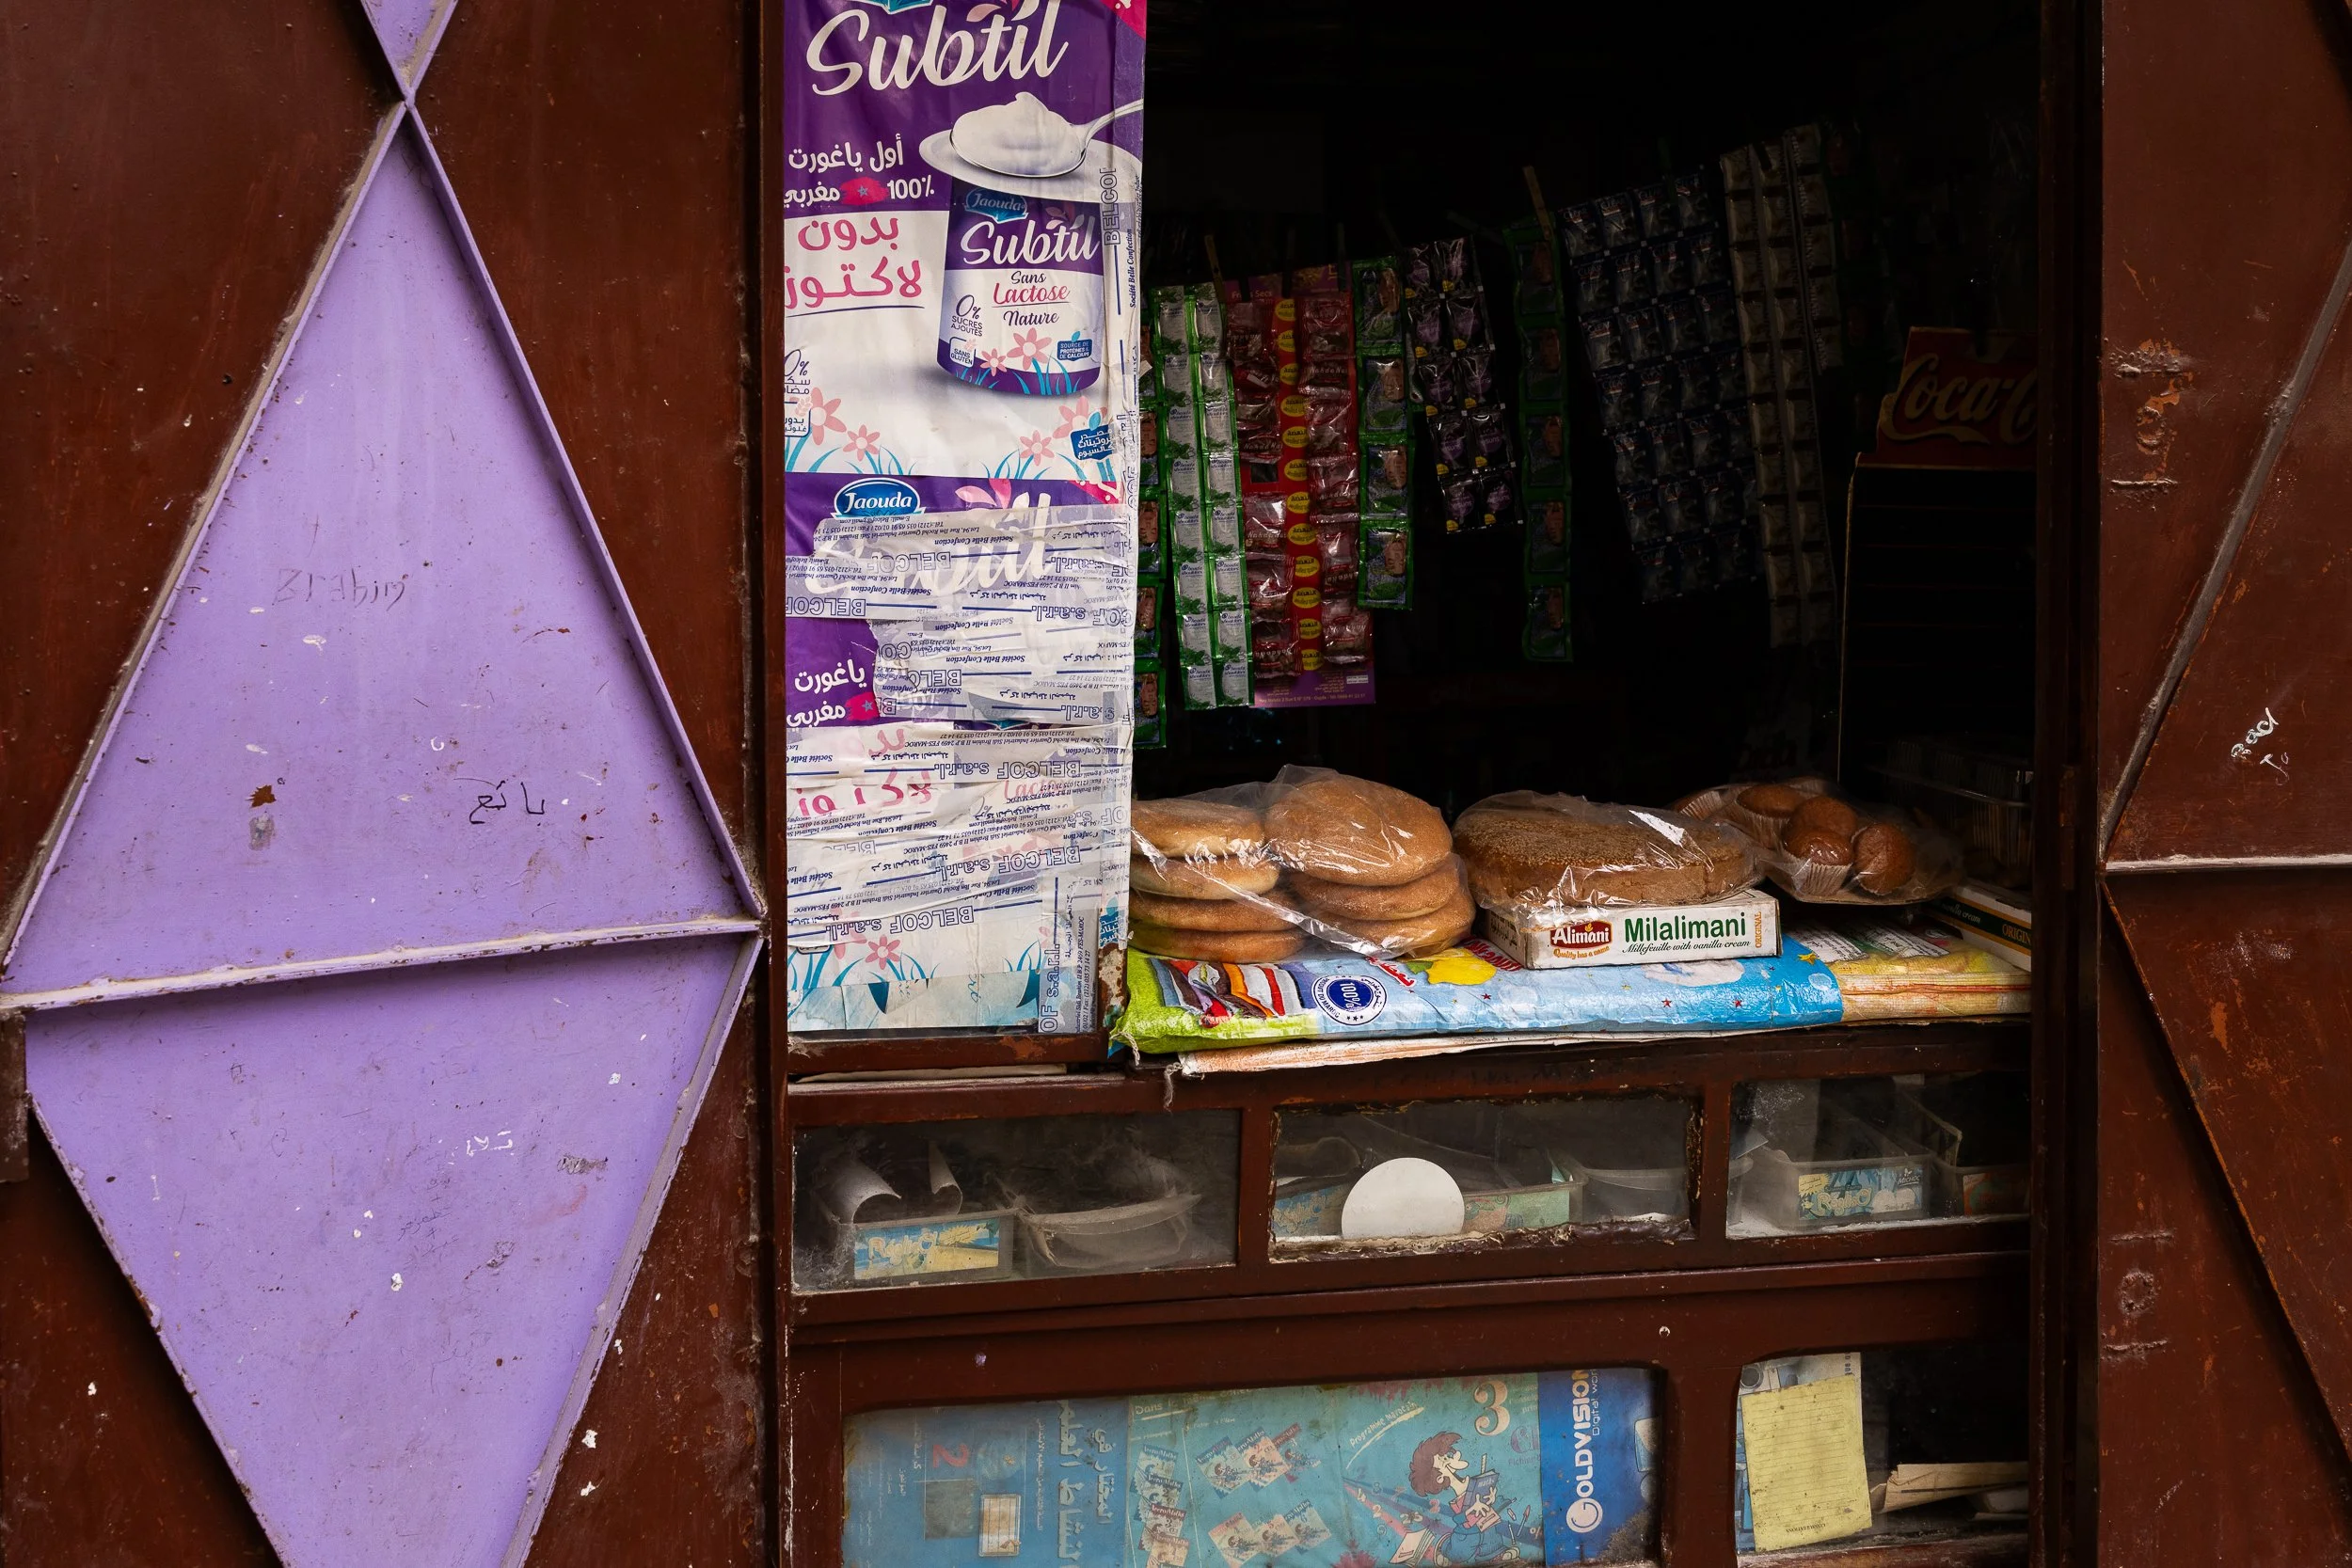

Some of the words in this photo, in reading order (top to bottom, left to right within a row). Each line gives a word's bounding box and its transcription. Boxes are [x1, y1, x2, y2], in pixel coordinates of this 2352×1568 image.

[806, 0, 1069, 96] Subtil
[788, 142, 862, 174] ياغورت
[869, 134, 904, 172] أول
[887, 174, 935, 200] 100%
[966, 192, 1024, 213] Jaouda
[798, 216, 899, 251] بدون
[961, 215, 1101, 264] Subtil
[1011, 271, 1047, 285] Sans
[993, 283, 1071, 305] Lactose
[956, 294, 982, 321] 0%
[1004, 310, 1060, 326] Nature
[951, 315, 983, 330] SUCRES
[950, 354, 973, 366] GLUTEN
[953, 348, 971, 359] SANS
[1879, 353, 2038, 446] Coca-C
[845, 491, 913, 513] Jaouda
[935, 538, 970, 546] Confection
[850, 585, 887, 594] Confection
[970, 590, 990, 599] شركة
[1019, 593, 1046, 601] الجميلة
[1032, 606, 1086, 621] s.a.r.l.
[935, 622, 970, 631] Confection
[795, 659, 866, 694] ياغورت
[882, 685, 917, 693] Confection
[787, 705, 846, 728] مغربي
[1065, 747, 1101, 755] Confection
[933, 762, 989, 780] s.a.r.l.
[997, 760, 1080, 779] BELCOF
[896, 823, 913, 832] Belle
[871, 863, 891, 872] شركة
[893, 859, 919, 868] الخياطة
[922, 854, 948, 863] الجميلة
[935, 859, 990, 881] s.a.r.l.
[998, 846, 1080, 873] BELCOF
[809, 872, 833, 880] Société
[894, 891, 919, 900] Industriel
[920, 888, 943, 896] Quartier
[1010, 884, 1035, 895] Société
[794, 903, 830, 913] FES-MAROC
[825, 919, 882, 941] s.a.r.l.
[889, 906, 974, 934] BELCOF
[1625, 911, 1745, 942] Milalimani
[1553, 927, 1610, 944] Alimani
[2001, 924, 2032, 945] ORIGIN
[1553, 948, 1576, 959] Quality
[1622, 942, 1672, 955] Millefeuille
[1673, 942, 1692, 951] with
[1693, 941, 1723, 949] vanilla
[1044, 943, 1060, 997] s.a.r.l.
[1135, 1402, 1164, 1415] Dans
[1474, 1379, 1511, 1436] 3
[1591, 1398, 1600, 1436] Digital
[1092, 1428, 1116, 1454] في
[1349, 1417, 1386, 1448] Programme
[932, 1443, 970, 1468] 2
[1094, 1459, 1115, 1524] المختار
